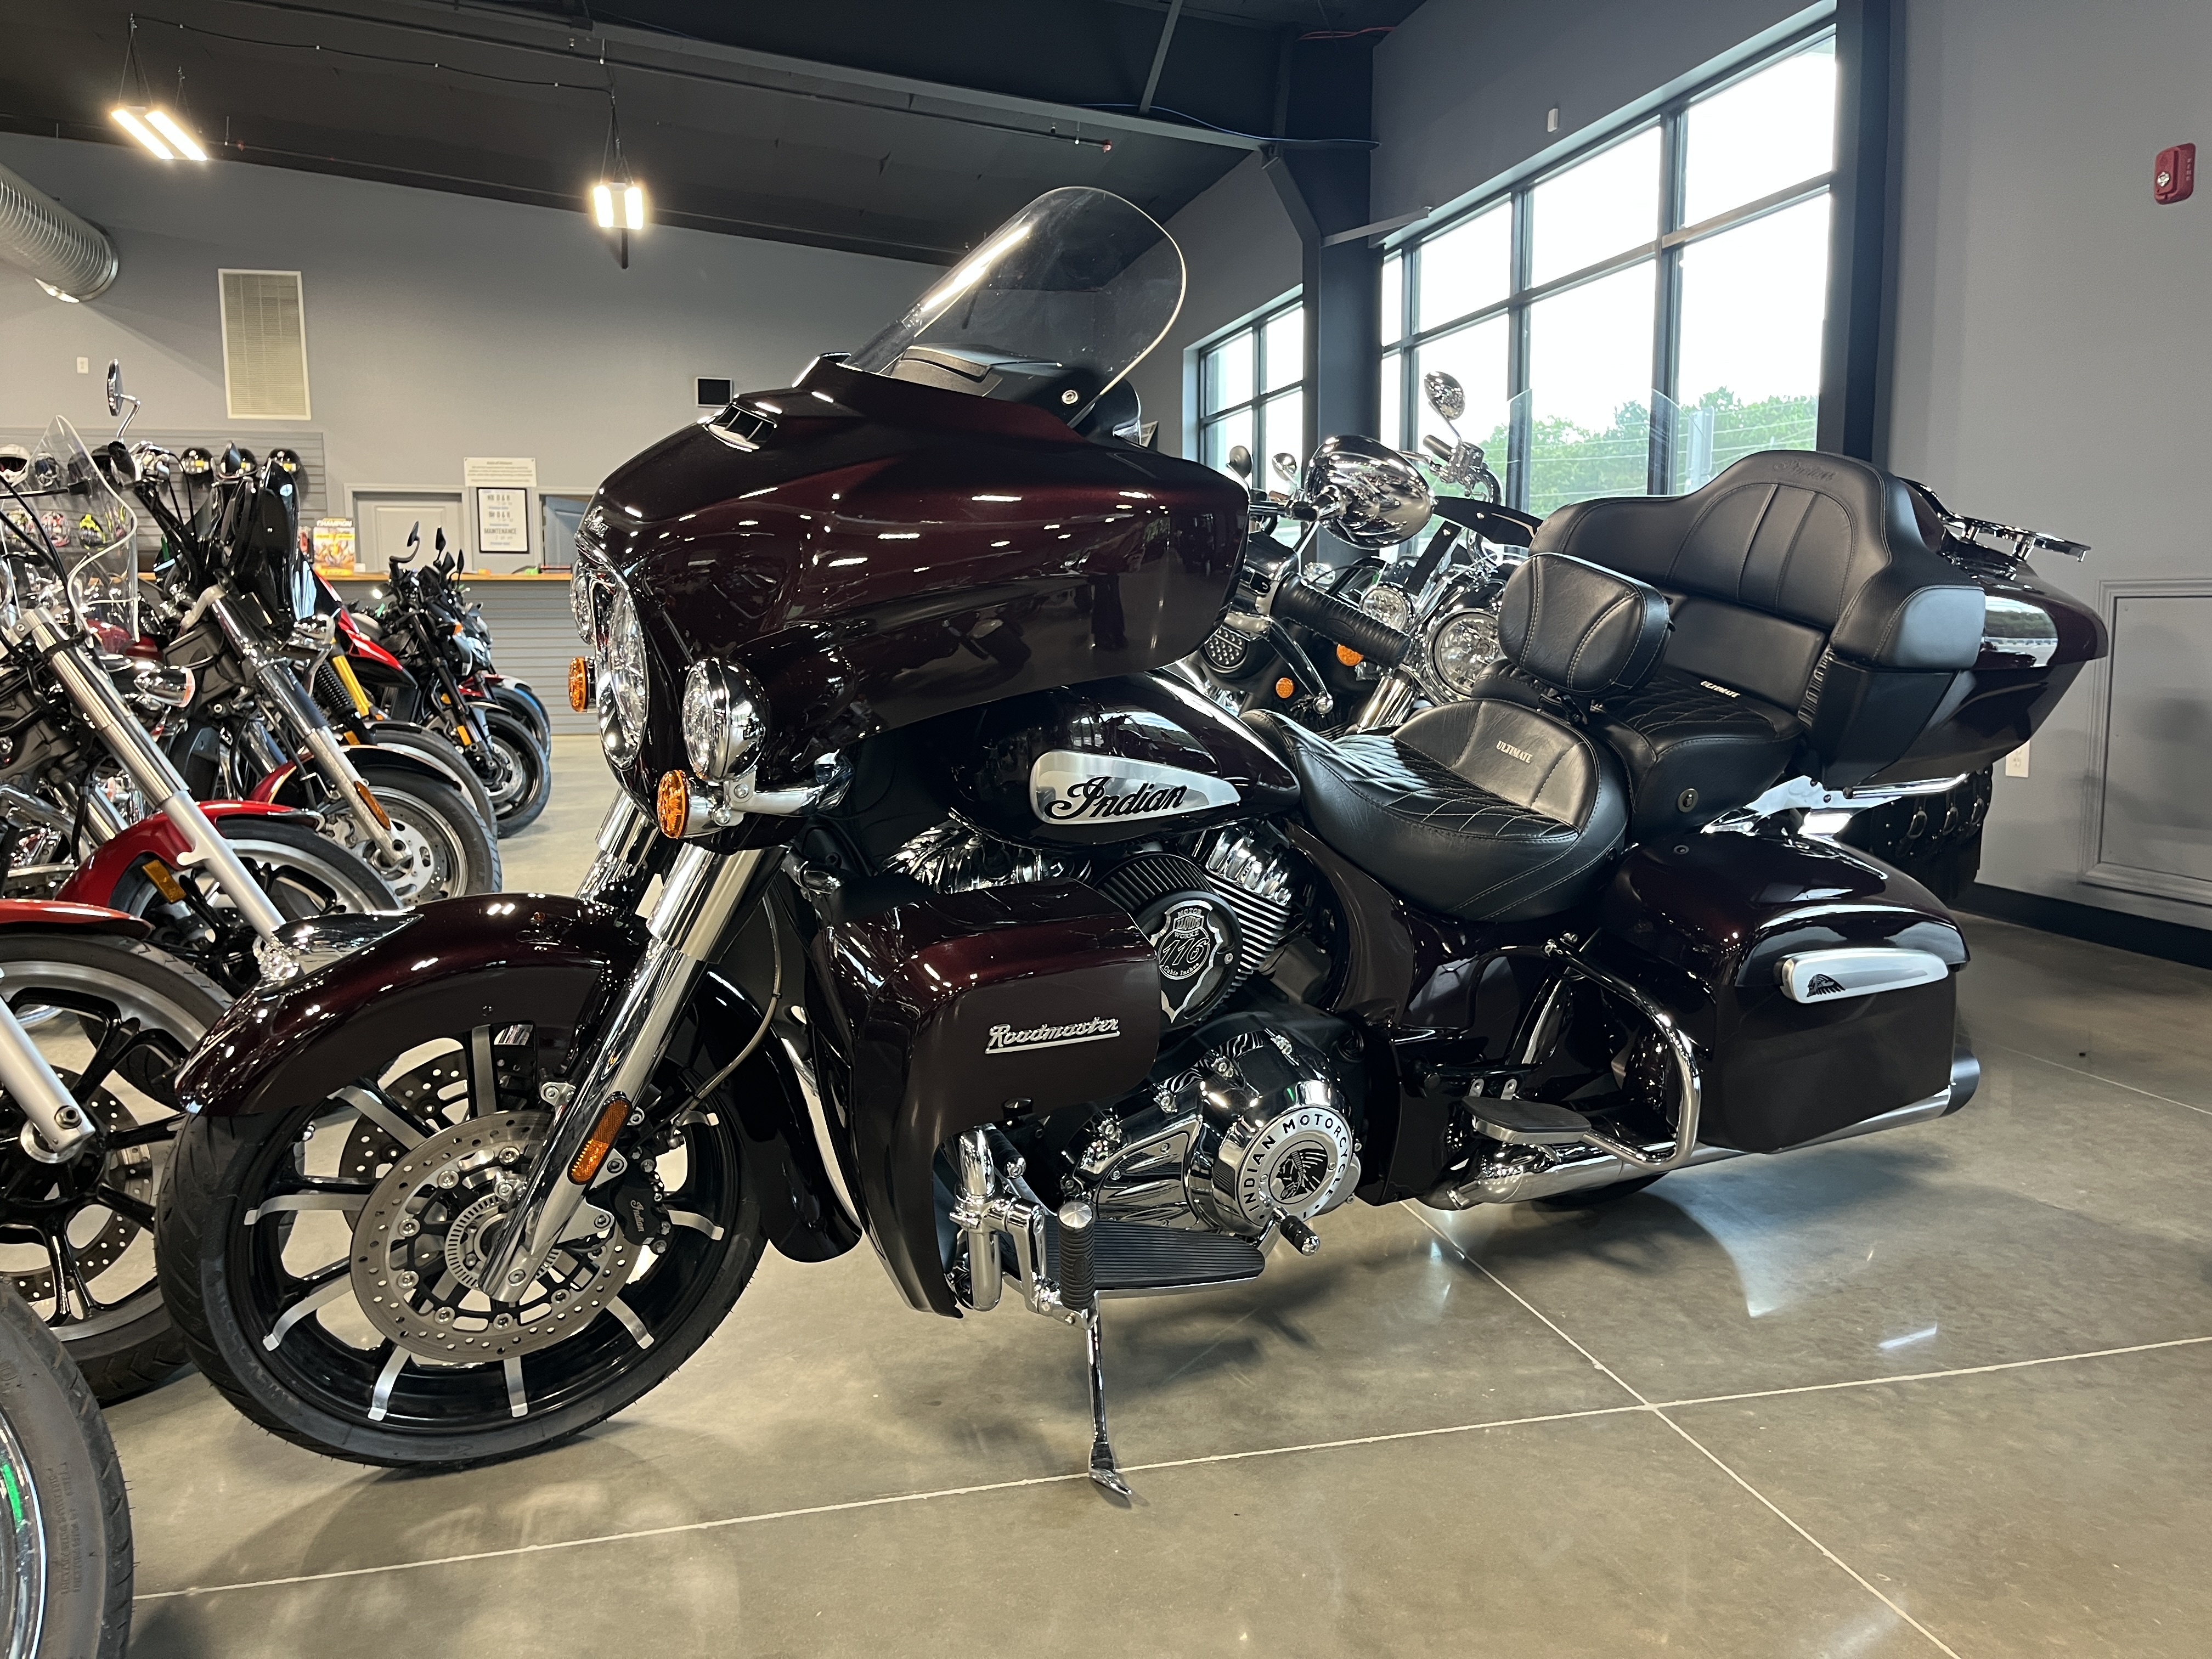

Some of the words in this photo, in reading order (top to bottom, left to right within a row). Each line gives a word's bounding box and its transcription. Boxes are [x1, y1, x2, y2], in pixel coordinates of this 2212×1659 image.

[1700, 681, 1741, 698] ULTIMATE
[1496, 740, 1533, 764] ULTIMATE
[1044, 776, 1188, 820] Indian
[1177, 908, 1202, 917] MOTOR
[1174, 930, 1200, 939] WORKZ
[1159, 937, 1210, 966] 116
[1164, 965, 1178, 976] Cubic
[1180, 963, 1199, 976] Inches
[988, 1017, 1119, 1049] Roadmaster
[1244, 1135, 1276, 1212] INDIAN
[1282, 1114, 1347, 1198] MOTORCYCLE
[630, 1199, 645, 1232] Indian
